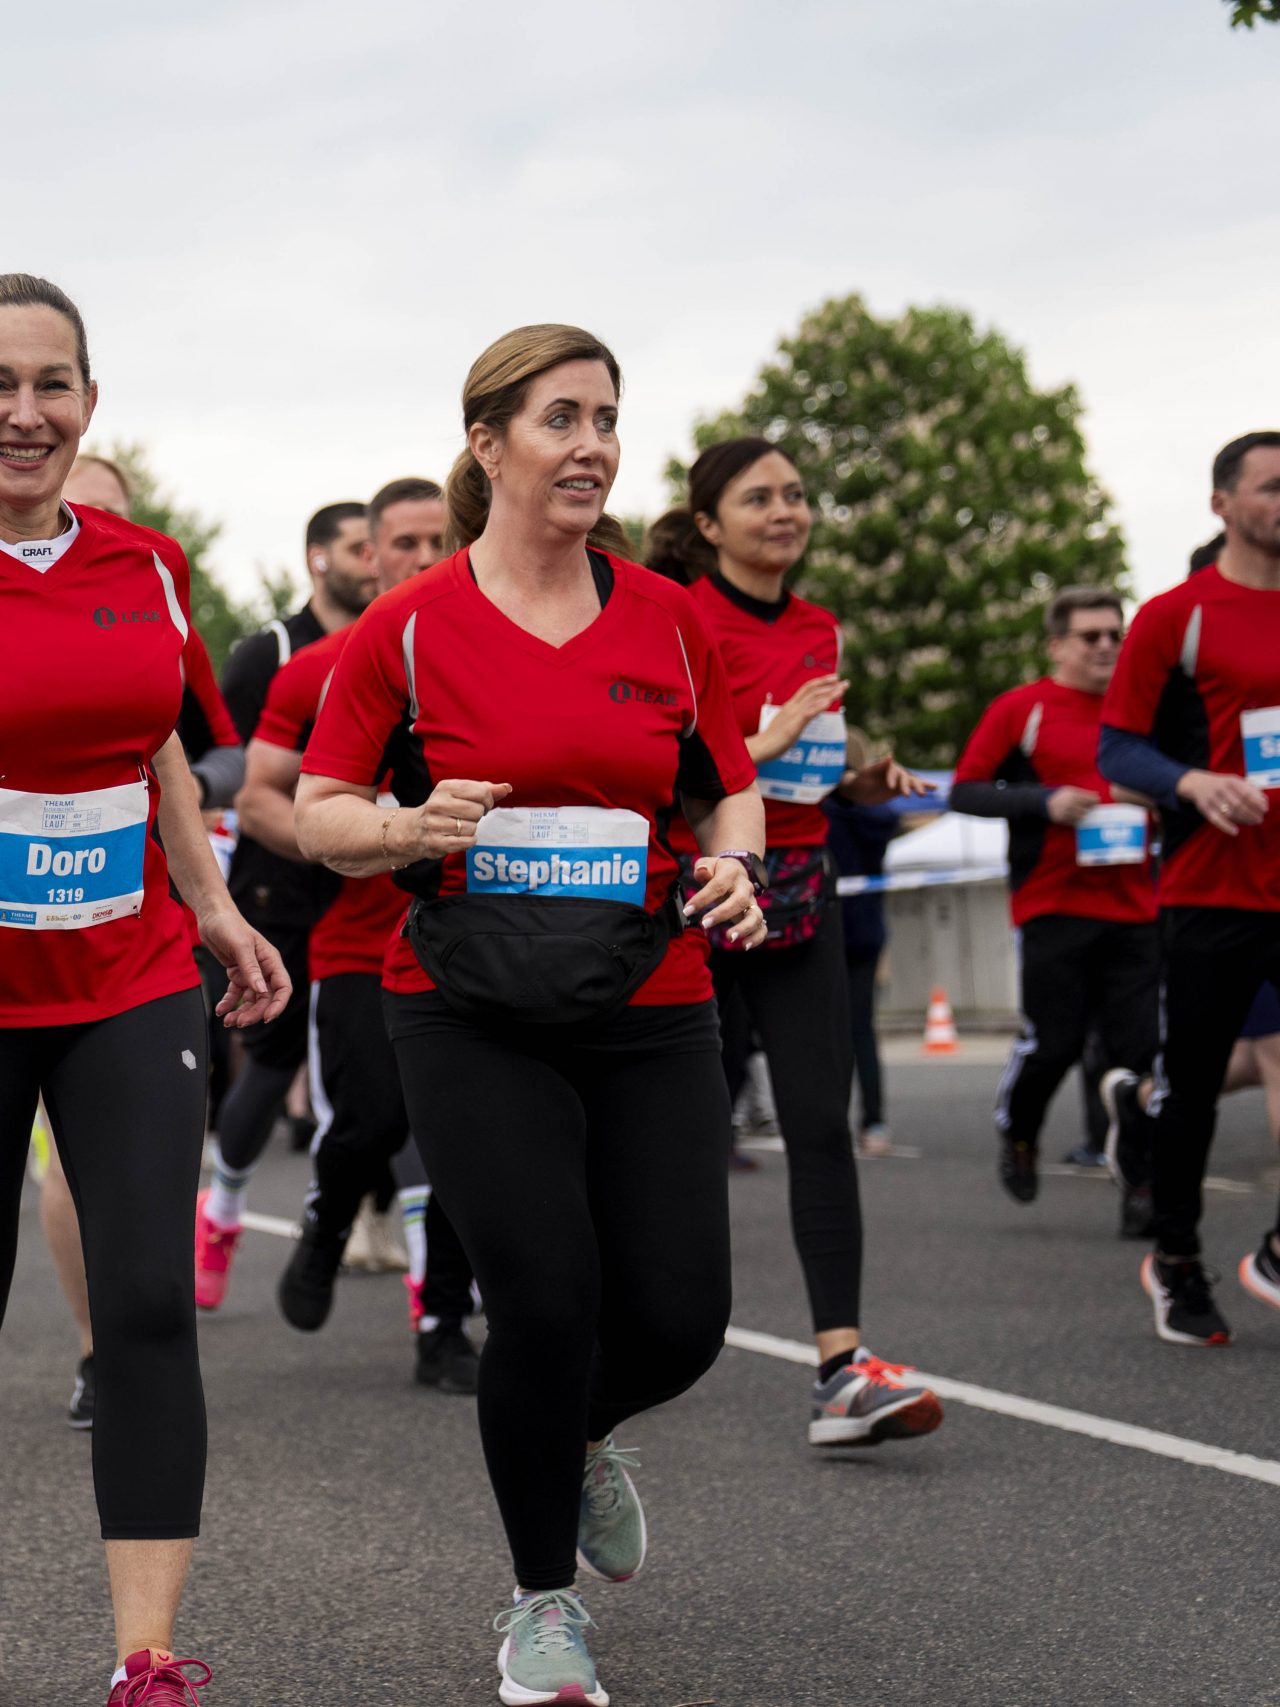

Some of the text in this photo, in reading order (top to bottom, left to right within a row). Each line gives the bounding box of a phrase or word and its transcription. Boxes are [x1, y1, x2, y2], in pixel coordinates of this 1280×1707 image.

[22, 547, 52, 557] CRAFT
[122, 610, 160, 624] LEAR
[44, 820, 64, 828] LAUF
[26, 843, 106, 876] Doro
[473, 852, 640, 890] Stephanie
[47, 888, 84, 903] 1319
